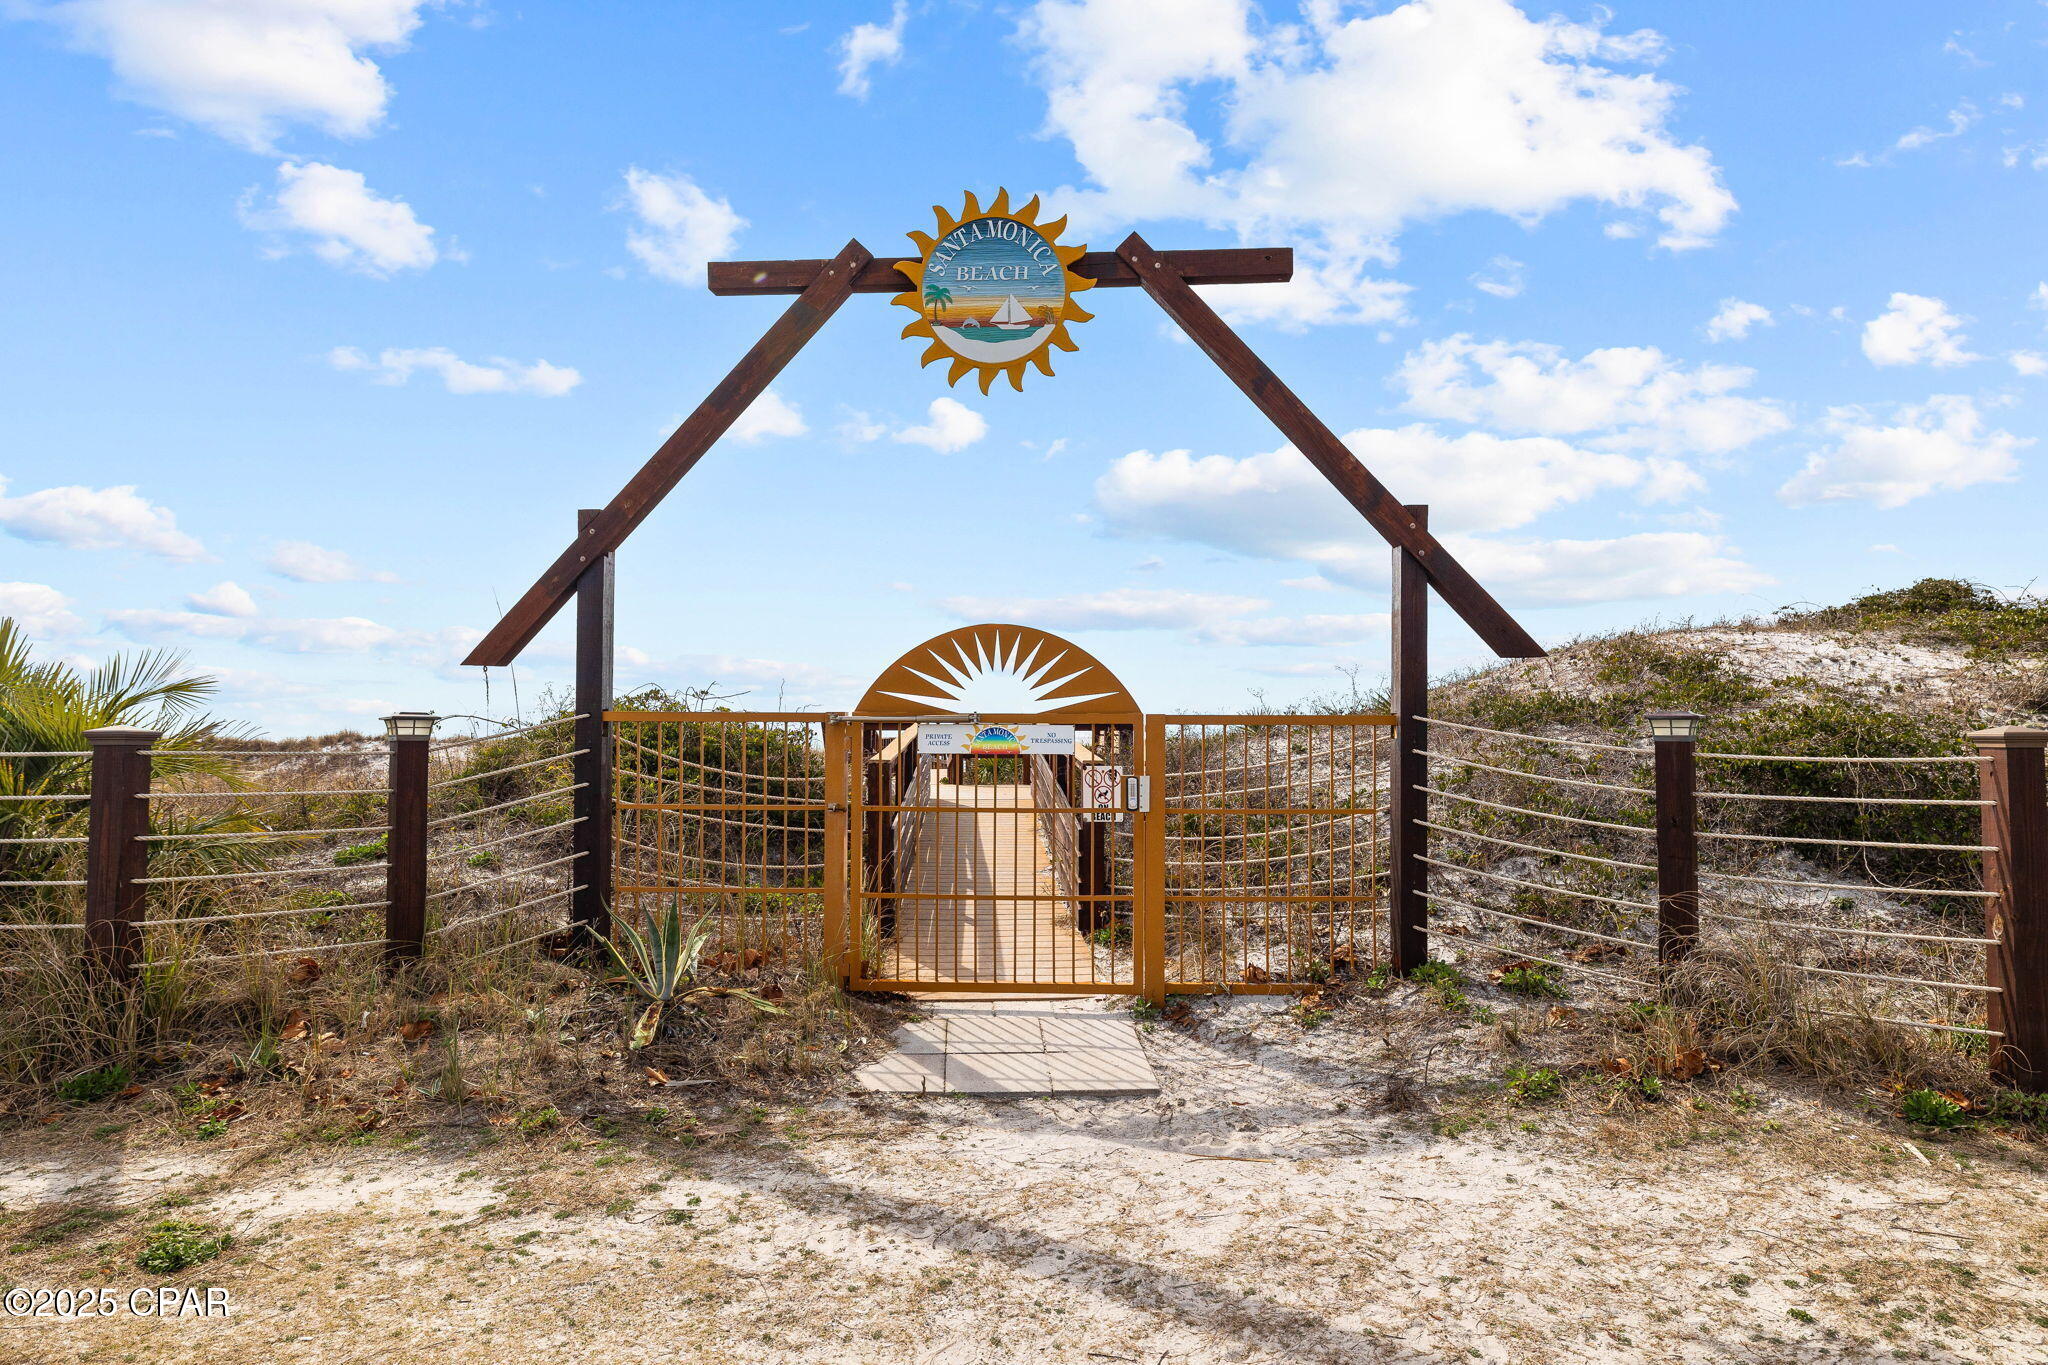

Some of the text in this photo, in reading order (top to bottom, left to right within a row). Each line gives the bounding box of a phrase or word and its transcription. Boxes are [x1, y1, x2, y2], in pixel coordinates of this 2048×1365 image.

[928, 219, 1058, 277] SANTA MONICA
[956, 265, 1030, 281] BEACH
